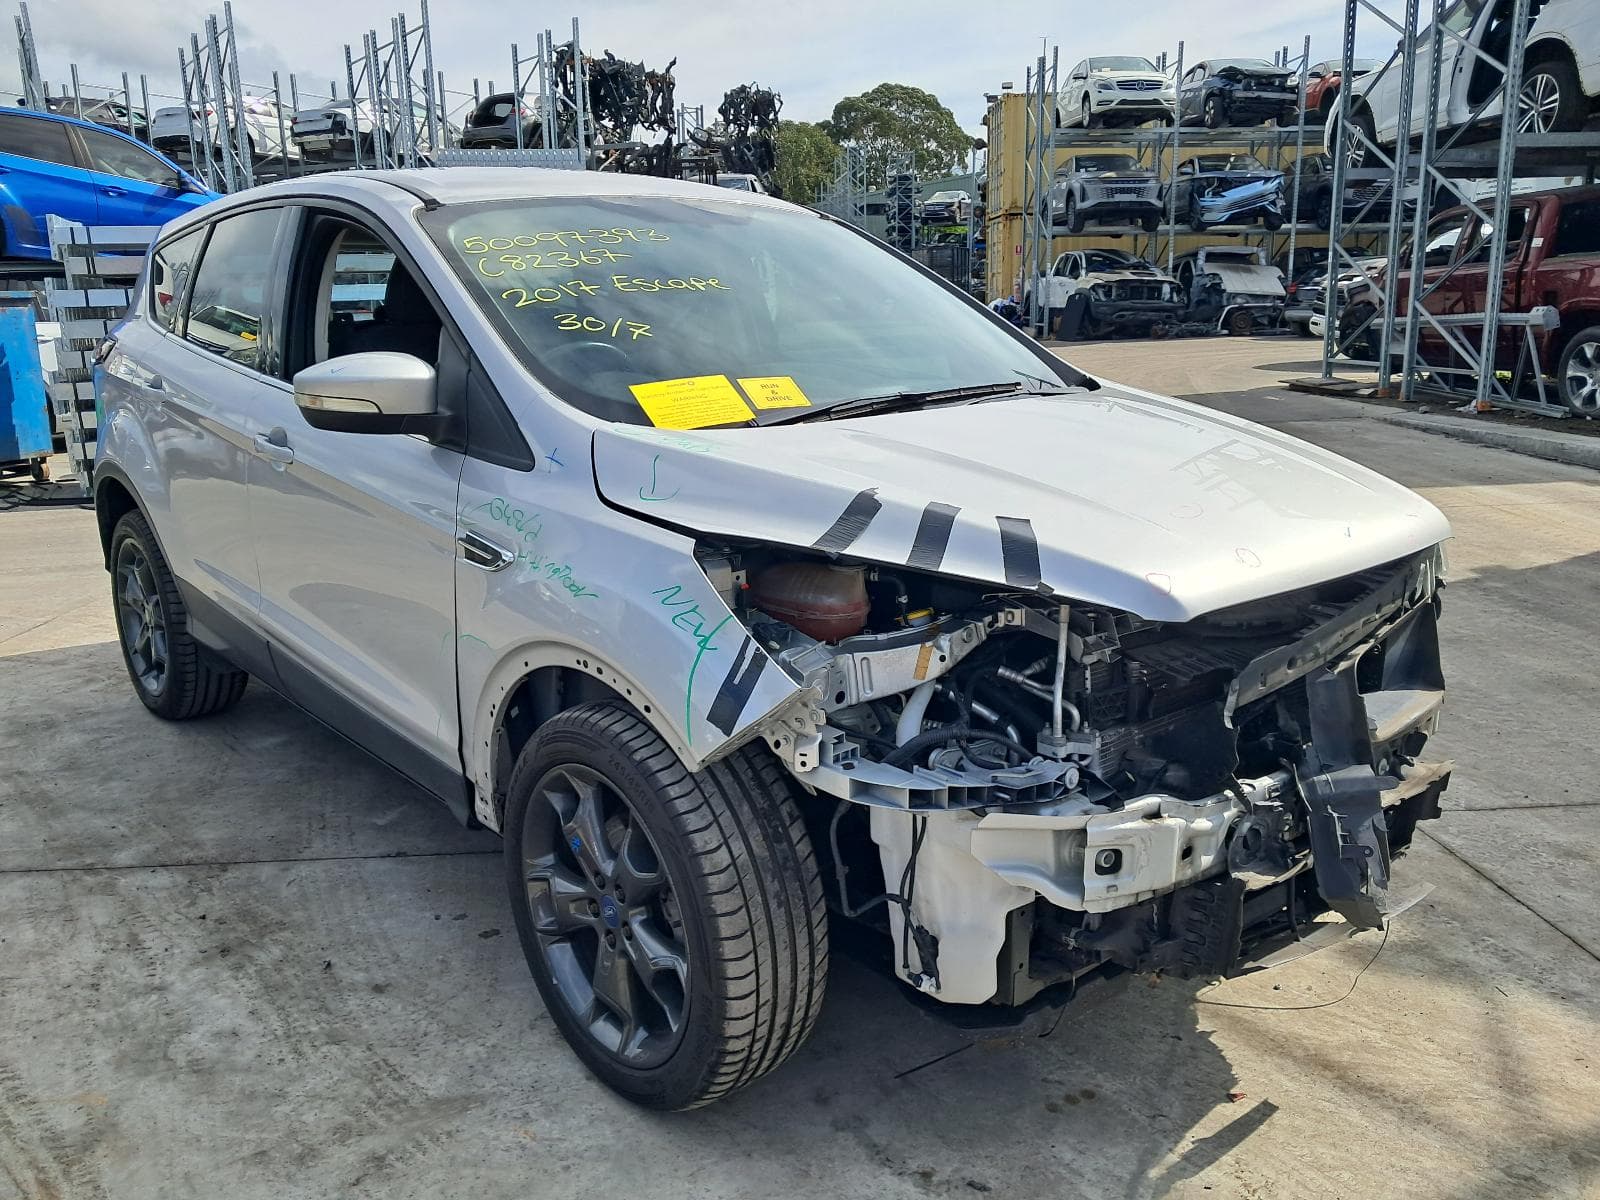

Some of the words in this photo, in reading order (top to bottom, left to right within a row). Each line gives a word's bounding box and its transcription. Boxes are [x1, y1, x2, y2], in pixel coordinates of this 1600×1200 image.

[463, 228, 671, 254] 50097393
[478, 248, 633, 277] C82367
[501, 279, 601, 308] 2017
[553, 313, 653, 340] 30/7
[760, 383, 781, 391] RUN
[765, 395, 793, 403] DRIVE
